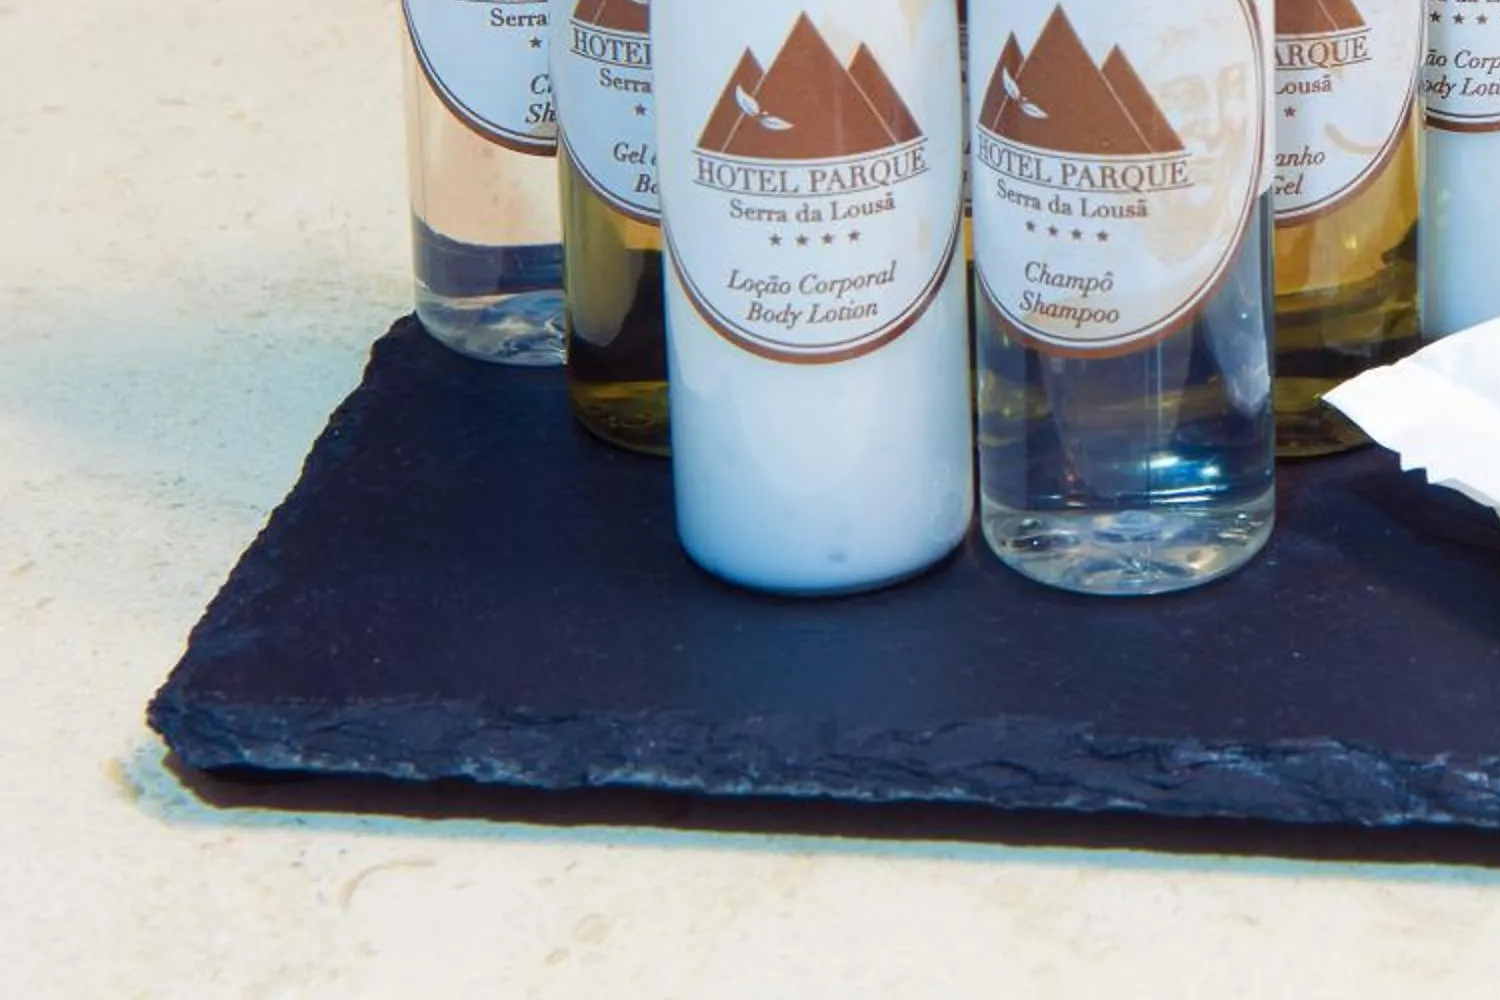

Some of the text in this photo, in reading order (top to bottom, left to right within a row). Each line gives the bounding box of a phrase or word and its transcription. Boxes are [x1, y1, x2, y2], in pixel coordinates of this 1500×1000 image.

[490, 7, 548, 27] Serra
[599, 67, 653, 94] Serra
[612, 141, 647, 165] Gel
[696, 158, 800, 194] HOTEL
[810, 146, 926, 194] PARQUE
[978, 134, 1053, 183] HOTEL
[1059, 159, 1189, 192] PARQUE
[1275, 145, 1326, 167] anho
[729, 192, 896, 223] Serra da Lousã
[996, 178, 1150, 219] Serra da Lousã
[726, 260, 898, 299] Loção Corporal
[1024, 260, 1115, 298] Champô
[746, 300, 878, 330] Body Lotion
[1019, 290, 1120, 329] Shampoo
